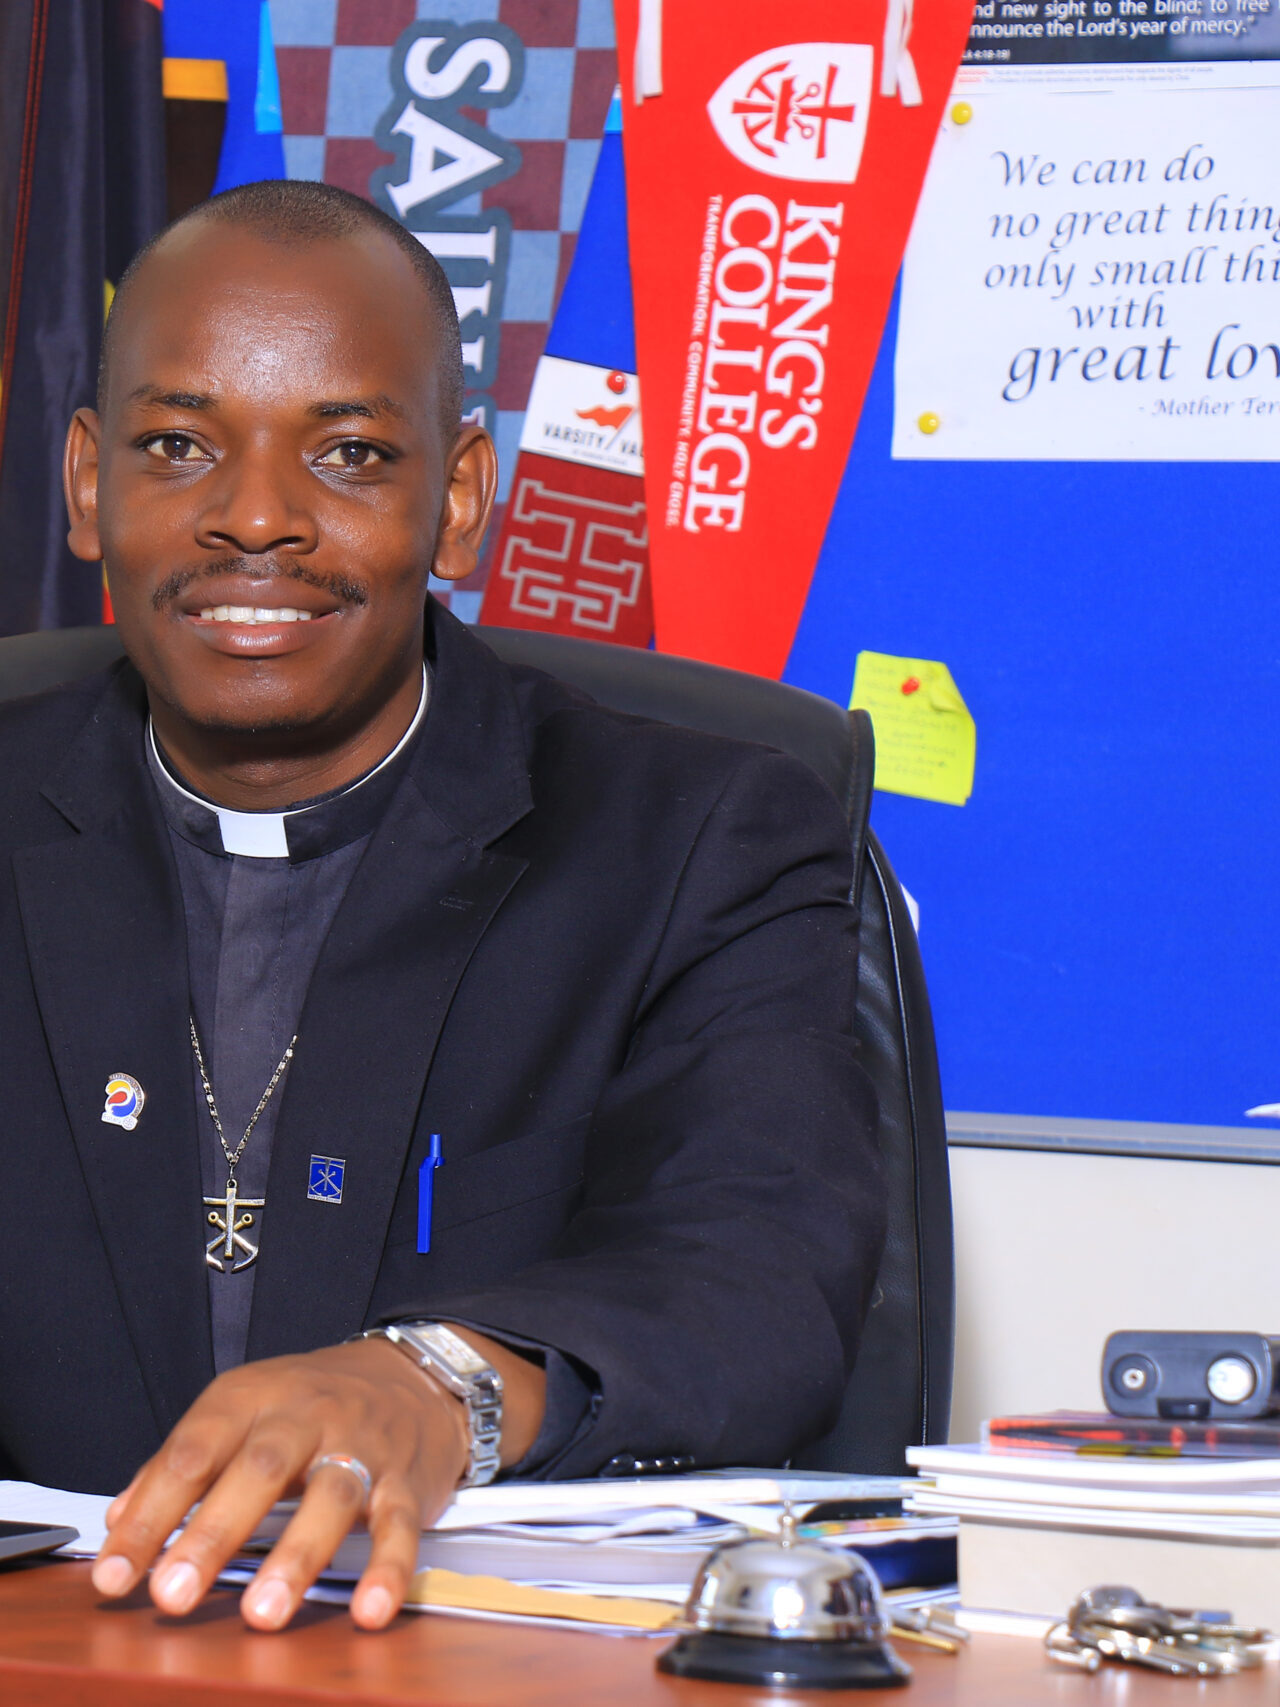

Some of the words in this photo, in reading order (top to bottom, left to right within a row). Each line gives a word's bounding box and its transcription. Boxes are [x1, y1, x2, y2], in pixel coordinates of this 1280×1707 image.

[1000, 3, 1038, 18] new
[1044, 0, 1087, 21] sight
[1093, 1, 1112, 16] to
[1119, 0, 1148, 15] the
[1154, 0, 1203, 15] blind;
[1210, 0, 1228, 13] to
[1236, 0, 1270, 13] free
[1045, 19, 1075, 37] the
[1077, 17, 1128, 36] Lord's
[1129, 20, 1168, 39] year
[1169, 15, 1189, 34] of
[991, 150, 1056, 187] We
[1072, 157, 1149, 185] can
[1163, 143, 1215, 183] do
[990, 212, 1040, 238] no
[1049, 202, 1170, 249] great
[984, 249, 1076, 300] only
[1089, 245, 1218, 287] small
[759, 199, 844, 449] KING'S
[1069, 290, 1168, 330] with
[683, 194, 781, 533] COLLEGE
[1002, 335, 1181, 402] great
[1151, 394, 1235, 416] Mother
[543, 422, 604, 448] VARSITY
